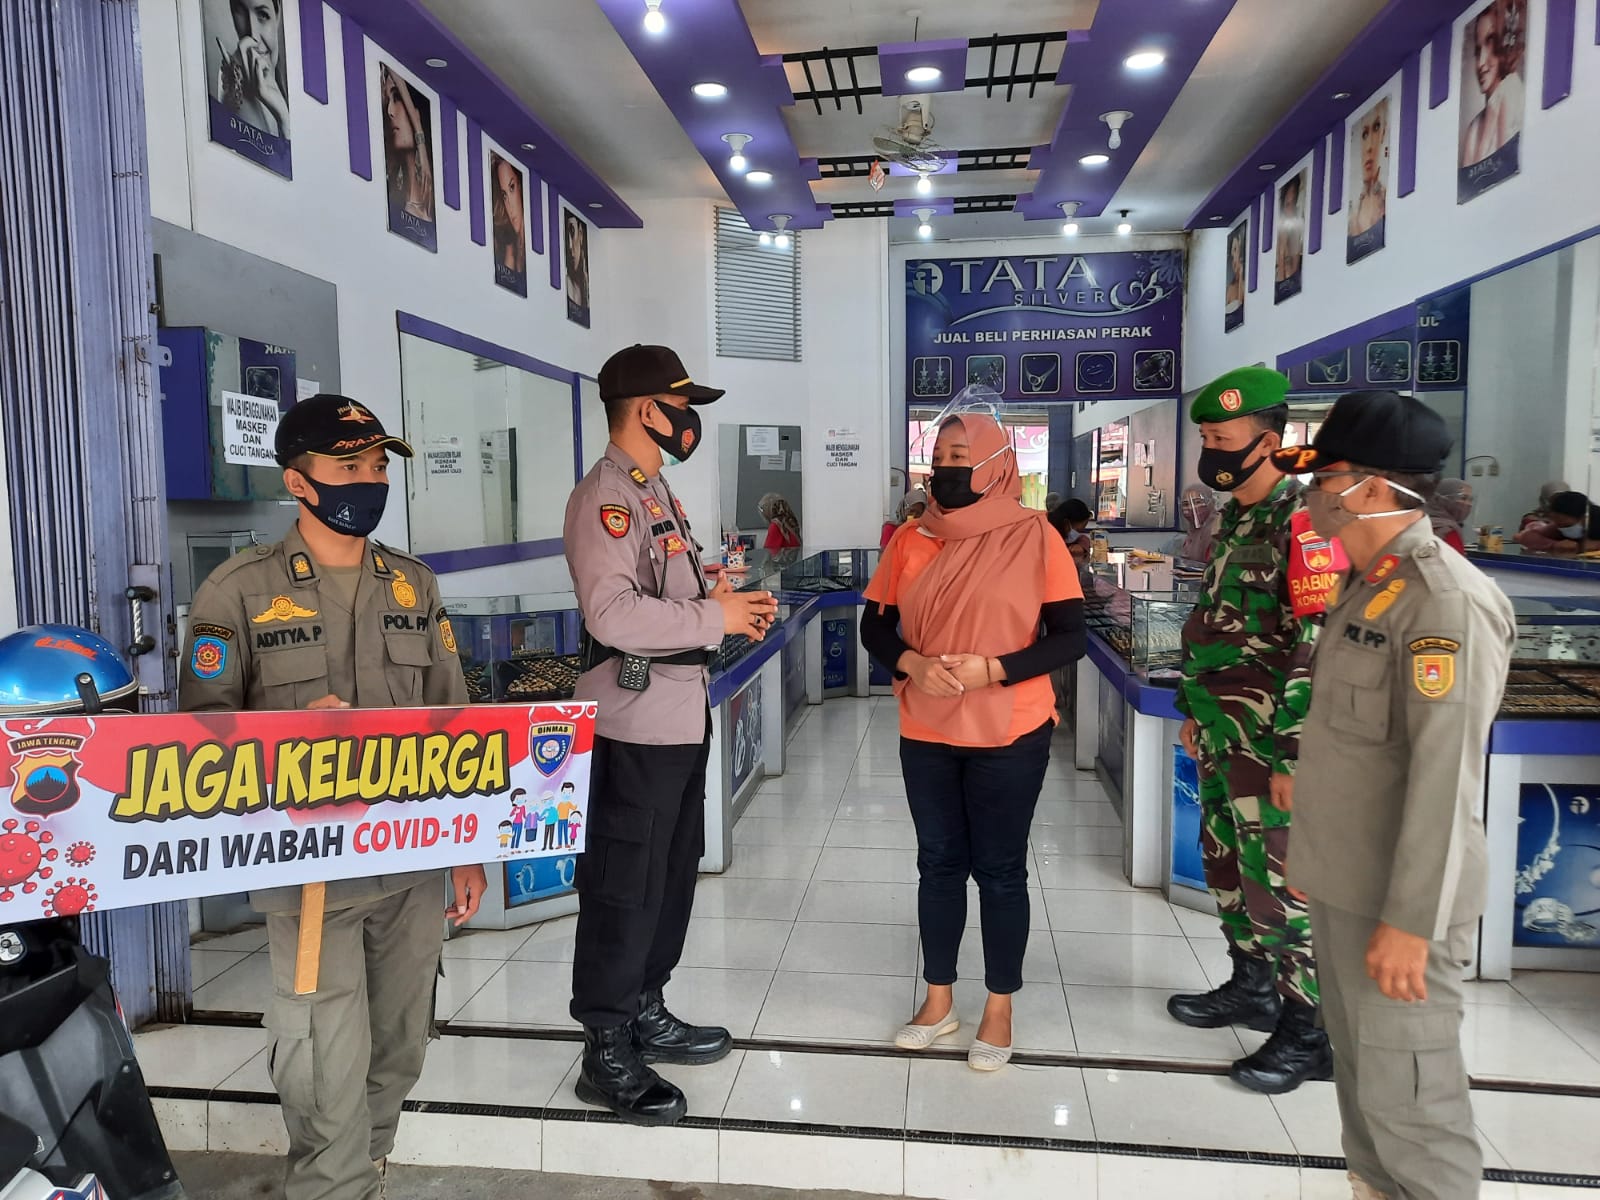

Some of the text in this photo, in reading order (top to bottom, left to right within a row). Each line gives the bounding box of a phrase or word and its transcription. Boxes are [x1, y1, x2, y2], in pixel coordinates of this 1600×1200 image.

[951, 257, 1100, 294] TATA
[1014, 291, 1105, 307] SILVER
[934, 326, 1152, 344] JUAL BELI PERHIASAN PERAK
[227, 398, 277, 422] WAJIB MENGGUNAKAN
[236, 419, 268, 434] MASKER
[243, 433, 261, 445] DAN
[230, 444, 274, 459] CUCI TANGAN
[1292, 573, 1338, 594] BABIN
[1297, 592, 1328, 607] KORA
[384, 613, 414, 631] POL
[312, 626, 322, 641] P
[1363, 629, 1386, 648] PP
[17, 737, 77, 749] JAWA TENGAH
[113, 731, 506, 819] JAGA KELUARGA
[123, 813, 479, 880] DARI WABAH COVID-19
